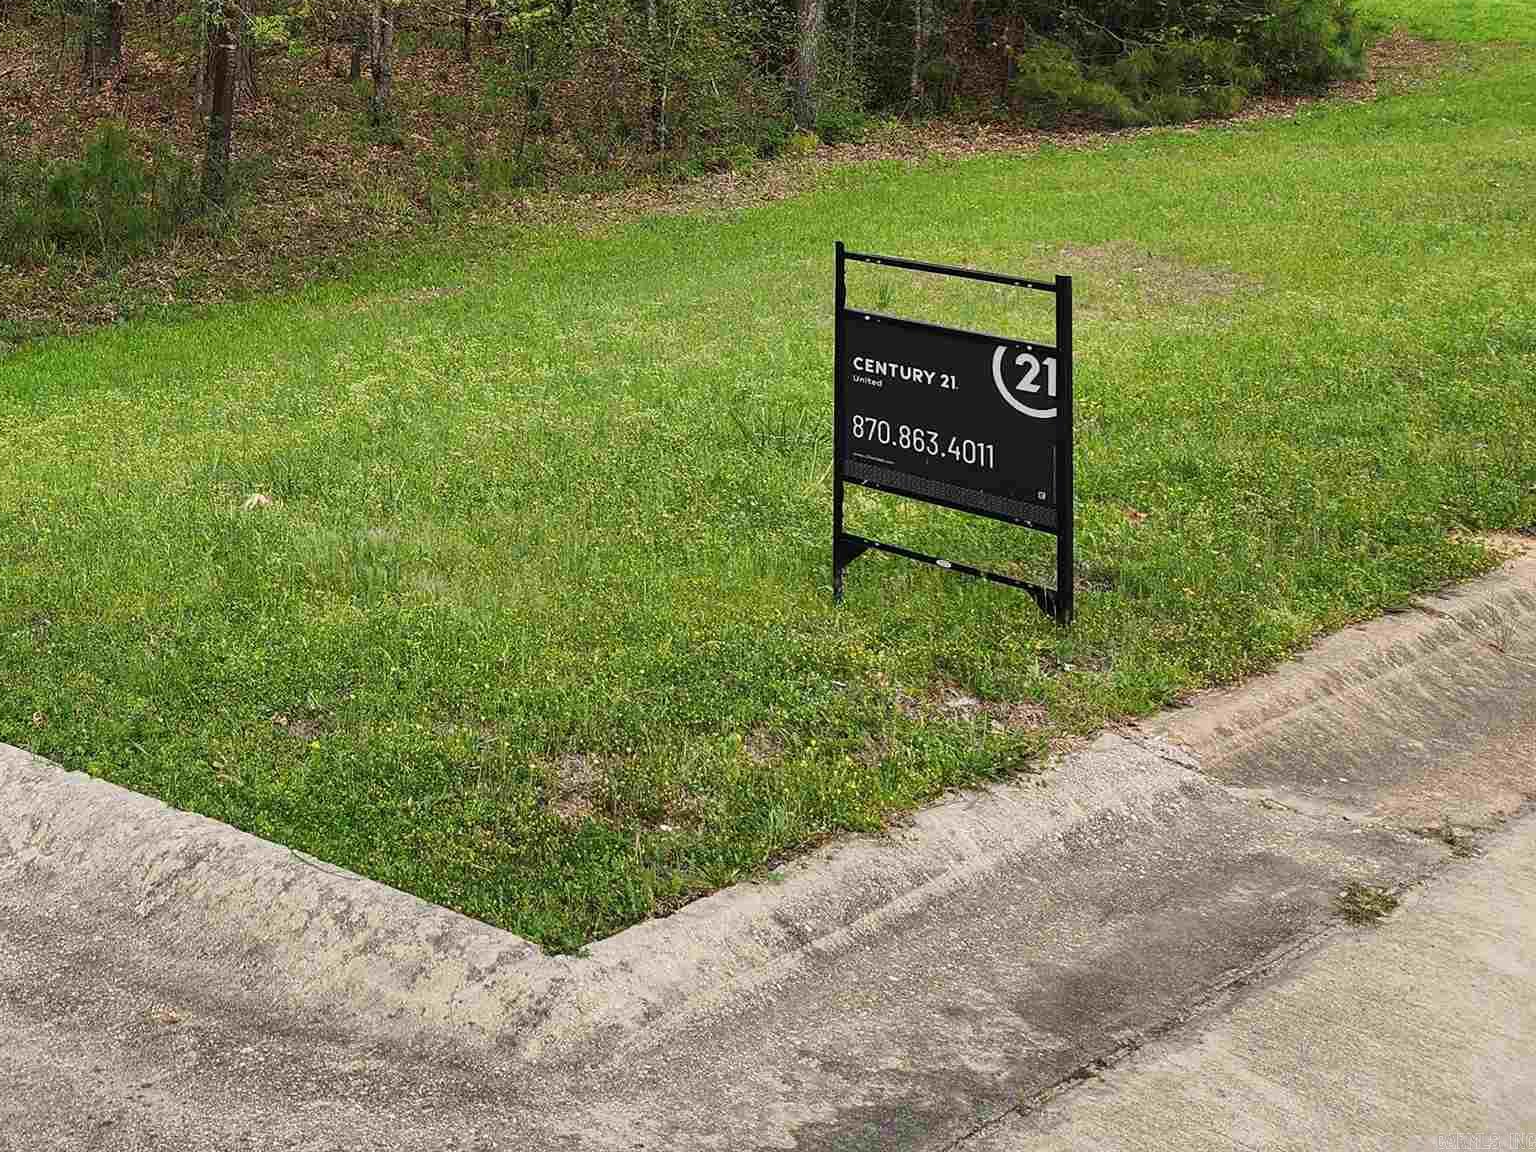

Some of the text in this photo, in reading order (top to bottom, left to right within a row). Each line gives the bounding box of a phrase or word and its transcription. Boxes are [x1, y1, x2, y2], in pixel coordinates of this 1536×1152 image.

[852, 356, 936, 385] CENTURY
[852, 375, 883, 387] United
[852, 414, 995, 470] 870.863.4011
